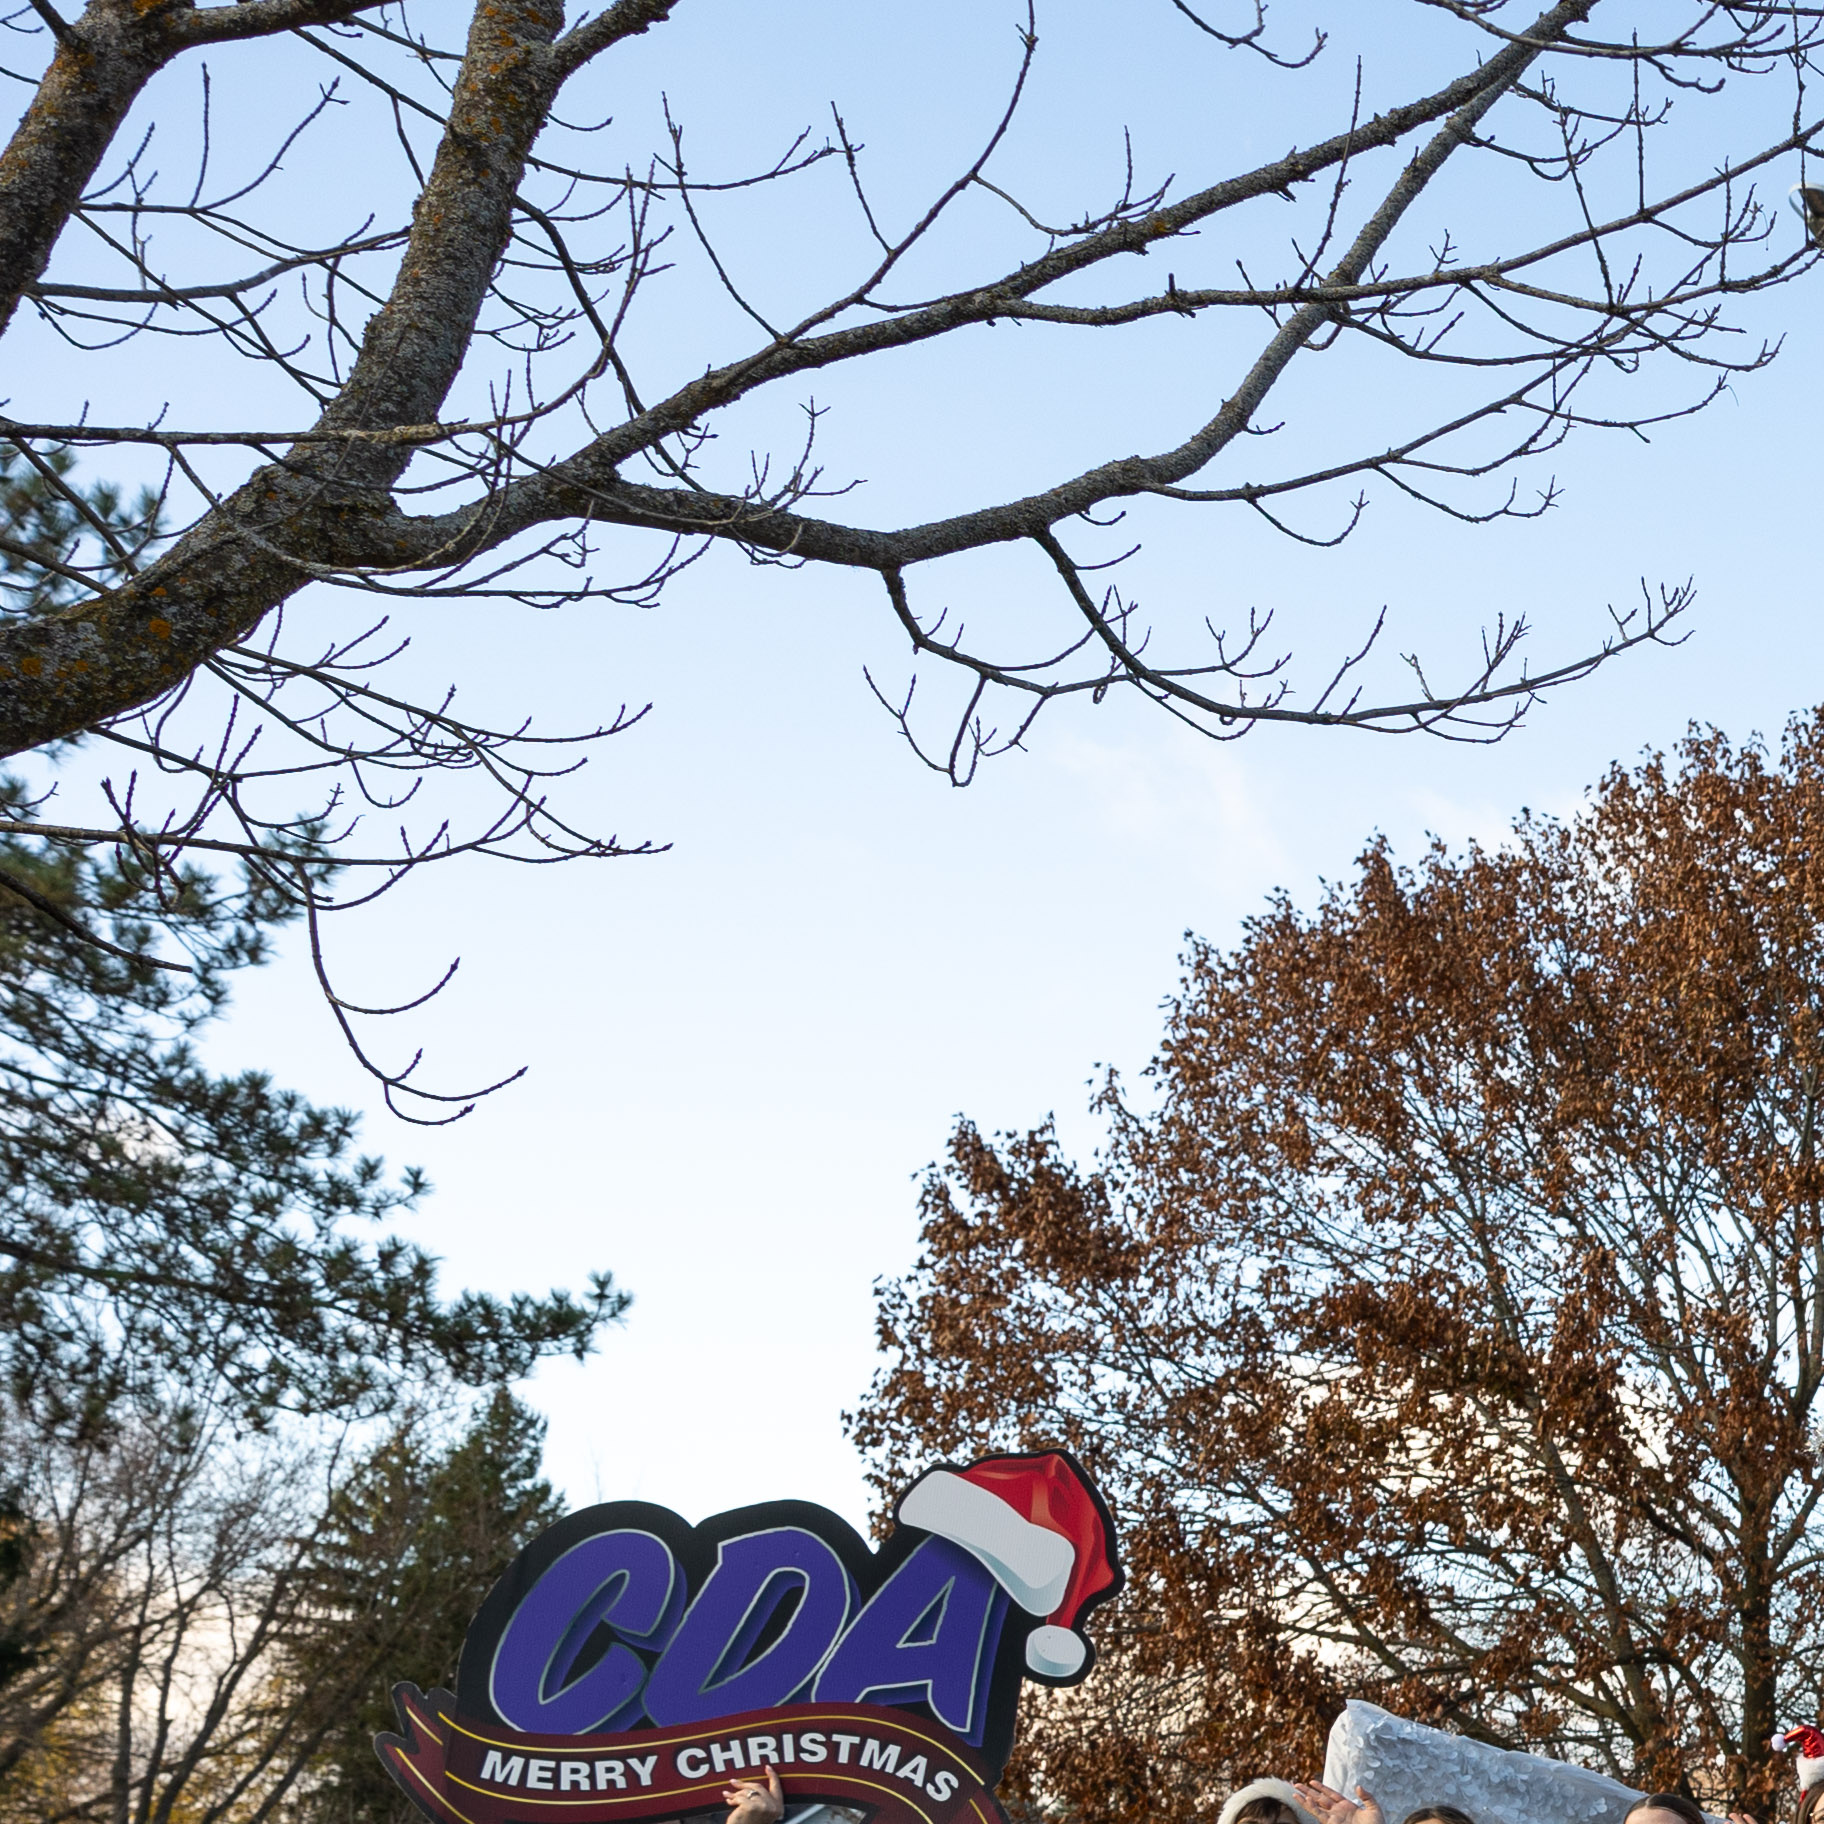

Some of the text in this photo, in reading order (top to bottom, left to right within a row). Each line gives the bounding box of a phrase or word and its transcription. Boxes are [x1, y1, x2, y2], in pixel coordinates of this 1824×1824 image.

[488, 1526, 1011, 1748] CDA
[480, 1732, 960, 1803] MERRY CHRISTMAS
